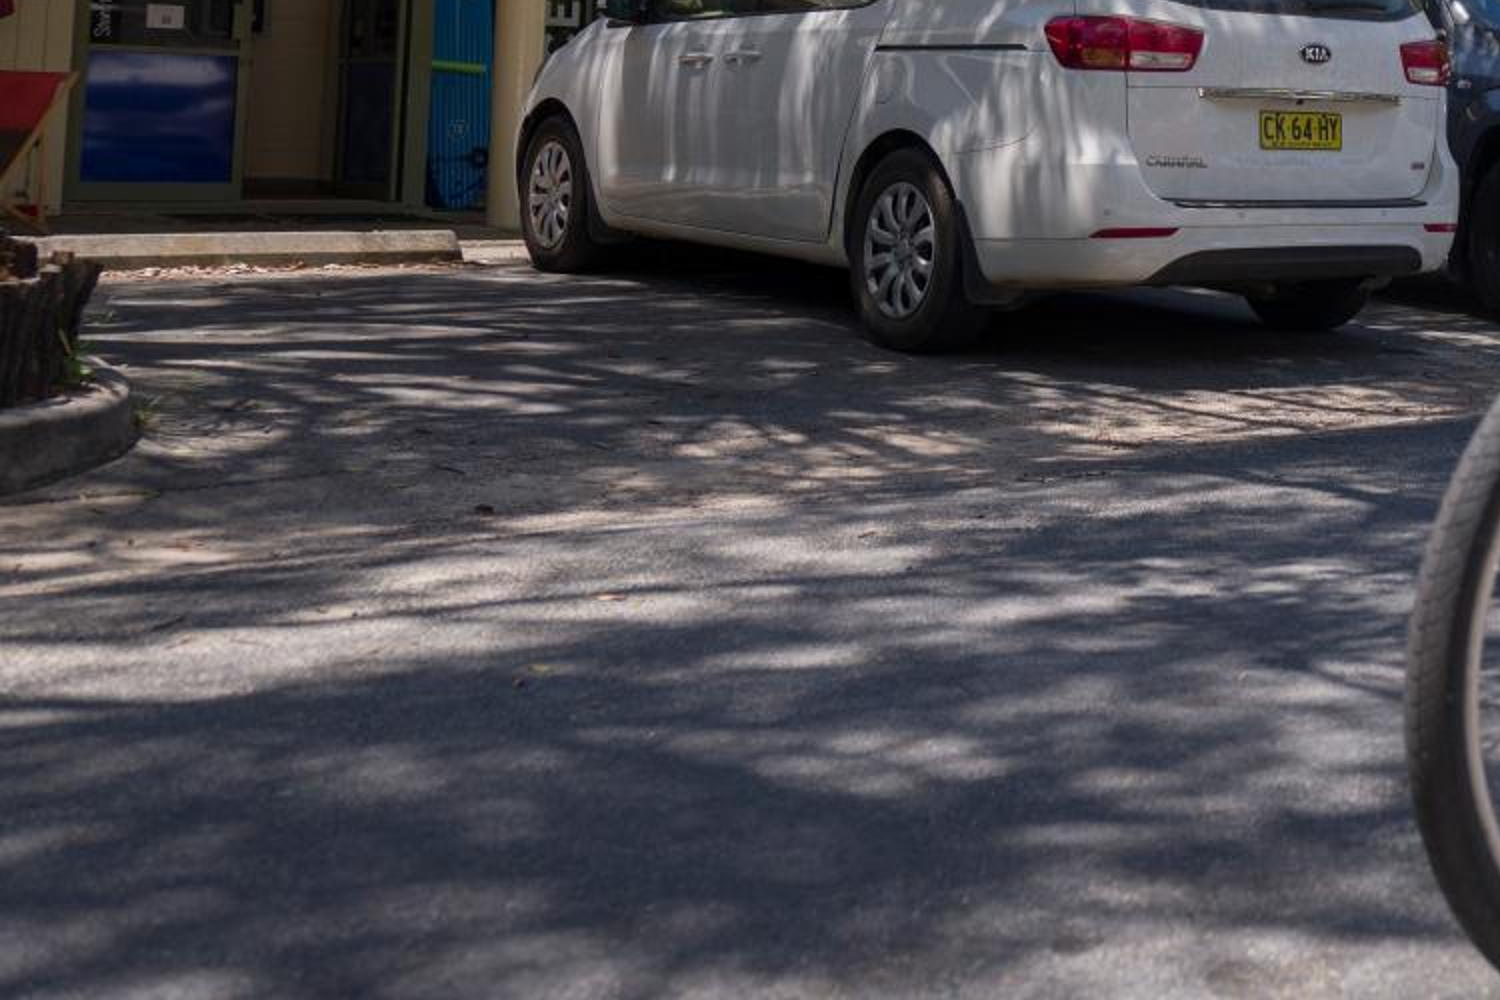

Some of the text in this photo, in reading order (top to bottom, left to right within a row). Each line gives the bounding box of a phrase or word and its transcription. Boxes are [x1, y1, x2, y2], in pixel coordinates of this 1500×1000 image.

[1306, 47, 1328, 61] KIA
[1264, 116, 1337, 140] CK 64 HY
